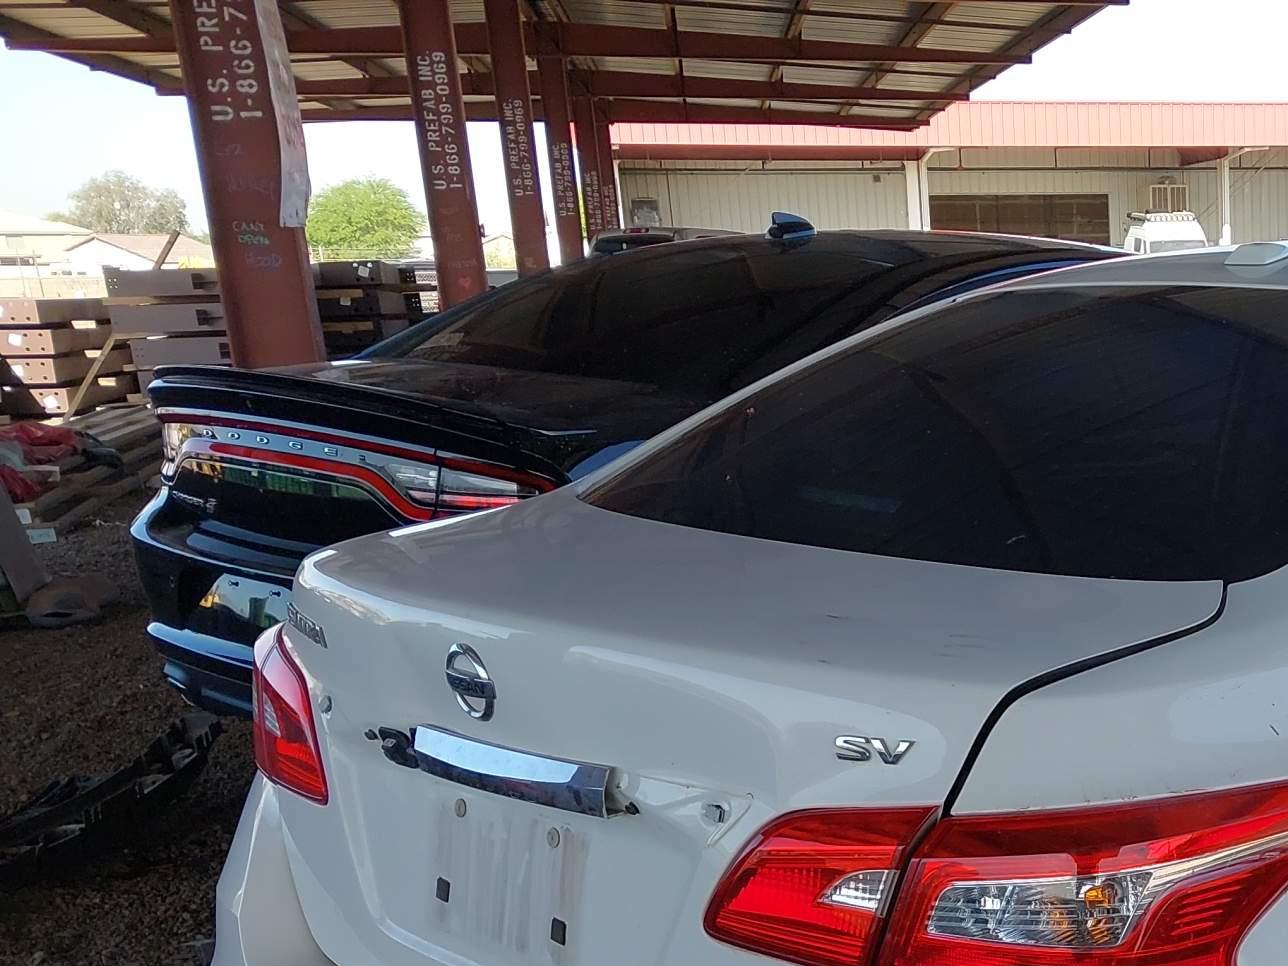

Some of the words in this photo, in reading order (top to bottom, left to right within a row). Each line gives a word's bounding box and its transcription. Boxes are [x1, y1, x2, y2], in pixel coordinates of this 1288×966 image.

[223, 0, 263, 119] 1-866-7
[416, 50, 433, 82] INC.
[207, 69, 234, 121] U.S.
[420, 88, 443, 152] PREFAB
[431, 51, 463, 189] 1-866-799-0969
[431, 160, 448, 190] U.S.
[201, 428, 339, 458] DODGE
[834, 734, 917, 766] SV
